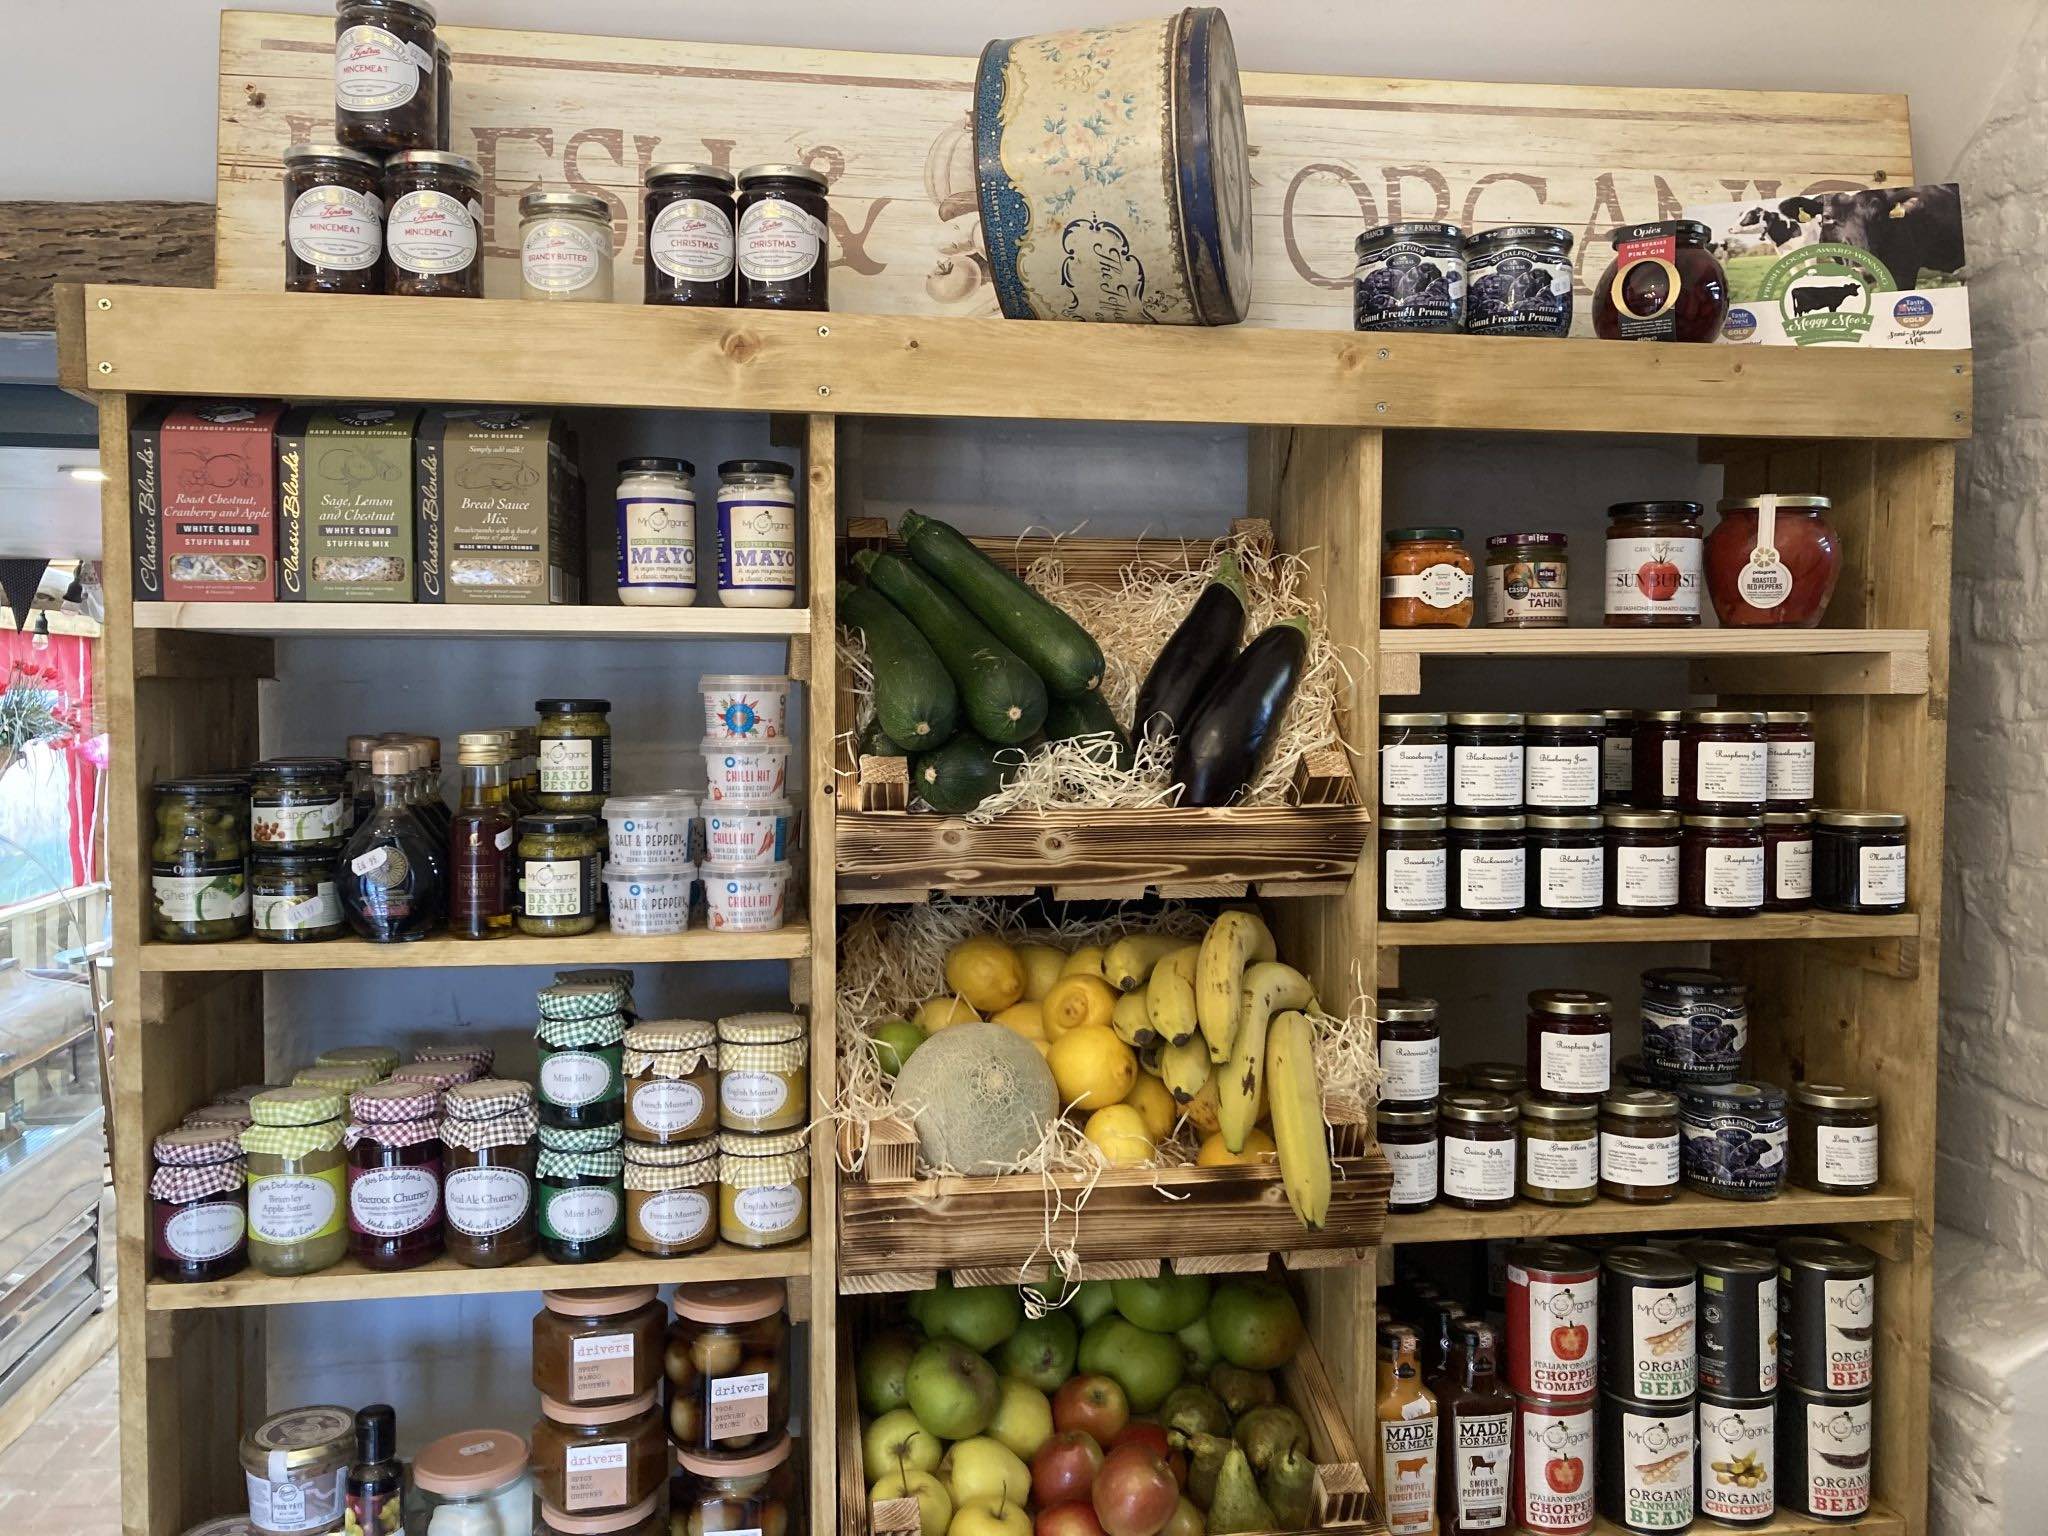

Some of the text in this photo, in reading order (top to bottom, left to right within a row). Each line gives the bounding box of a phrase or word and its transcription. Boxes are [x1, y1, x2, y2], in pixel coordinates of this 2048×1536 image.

[344, 65, 388, 74] MINCEMEAT
[310, 223, 361, 234] MINCEMEAT
[404, 229, 453, 238] MINCEMEAT
[1363, 224, 1442, 241] FRANCE FRANCE
[1507, 227, 1536, 236] FRANCE
[1633, 226, 1662, 238] Opies
[670, 239, 720, 251] CHRISTMAS
[749, 239, 797, 249] CHRISTMAS
[1391, 244, 1426, 256] DALFOUR
[528, 252, 588, 262] BRANDY BUTTER
[1501, 250, 1538, 261] DALFOUR
[1628, 250, 1647, 258] PINK
[1093, 243, 1123, 281] The
[1764, 273, 1776, 300] FRESH
[1780, 250, 1810, 270] LOCAL
[1360, 307, 1449, 324] Giant French Prunes
[1469, 311, 1558, 329] Giant French Prunes
[175, 493, 257, 505] Roast Chestnut,
[320, 494, 393, 508] Sage, Lemon
[461, 497, 531, 510] Bread Sauce
[164, 506, 270, 520] Cranberry and Apple
[319, 508, 395, 521] and Chestnut
[482, 512, 509, 525] Mix
[136, 447, 158, 592] Classic Blends
[282, 450, 301, 593] Classic Blends
[183, 525, 253, 533] WHITE CRUMB
[325, 527, 392, 535] WHITE CRUMB
[421, 455, 440, 597] Classic Blends
[184, 538, 251, 546] STUFFING MIX
[326, 540, 390, 548] STUFFING MIX
[630, 546, 695, 565] MAYO
[735, 549, 795, 567] MAYO
[1616, 573, 1697, 588] SUN BURST
[1752, 576, 1778, 584] ROASTED
[1508, 585, 1529, 593] taste
[1746, 583, 1783, 591] RED PEPPERS
[1465, 752, 1508, 761] Blackcurrant
[542, 771, 590, 781] BASIL
[726, 769, 771, 783] CHILLI HIT
[542, 781, 590, 791] PESTO
[285, 797, 309, 806] Opies
[615, 834, 633, 847] SALT
[635, 834, 642, 847] &
[713, 832, 755, 845] CHILLI HIT
[1472, 855, 1514, 865] Blackcurrant
[1639, 854, 1665, 863] Damson
[1724, 854, 1755, 866] Raspberry
[172, 865, 202, 877] Opies
[528, 893, 577, 904] BASIL
[728, 894, 773, 908] CHILLI HIT
[528, 904, 577, 914] PESTO
[1678, 986, 1705, 996] FRANCE
[1556, 1040, 1591, 1052] Raspberry
[1656, 1058, 1681, 1070] Giant
[1683, 1062, 1715, 1073] French
[553, 1072, 593, 1084] Mint Jelly
[726, 1087, 778, 1098] English Mustard
[639, 1098, 694, 1109] French Mustard
[1712, 1100, 1741, 1111] FRANCE
[1721, 1119, 1757, 1132] DALFOUR
[1551, 1141, 1588, 1152] Green Bean
[1711, 1175, 1747, 1187] French
[1748, 1179, 1777, 1188] Prunes
[268, 1194, 302, 1205] Bramley
[357, 1190, 431, 1204] Beetroot Chutney
[450, 1192, 518, 1205] Real Ale Chutney
[262, 1203, 312, 1215] Apple Sauce
[742, 1199, 796, 1212] English Mustard
[563, 1206, 605, 1219] Mint Jelly
[649, 1206, 703, 1220] French Mustard
[366, 1215, 423, 1230] Made with Love
[457, 1217, 511, 1230] Made with Love
[577, 1343, 631, 1358] drivers
[1533, 1360, 1568, 1371] ITALIAN
[714, 1382, 765, 1397] drivers
[714, 1412, 746, 1423] PICKLED
[1386, 1424, 1434, 1443] MADE
[1459, 1421, 1508, 1437] MADE
[1386, 1438, 1434, 1451] FOR MEAT
[1459, 1433, 1509, 1446] FOR MEAT
[570, 1454, 624, 1467] drivers
[1469, 1478, 1498, 1488] SMOKED
[1462, 1487, 1491, 1497] PEPPER
[1529, 1493, 1564, 1503] ITALIAN
[1705, 1488, 1773, 1505] ORGANIC
[1814, 1487, 1839, 1498] RED
